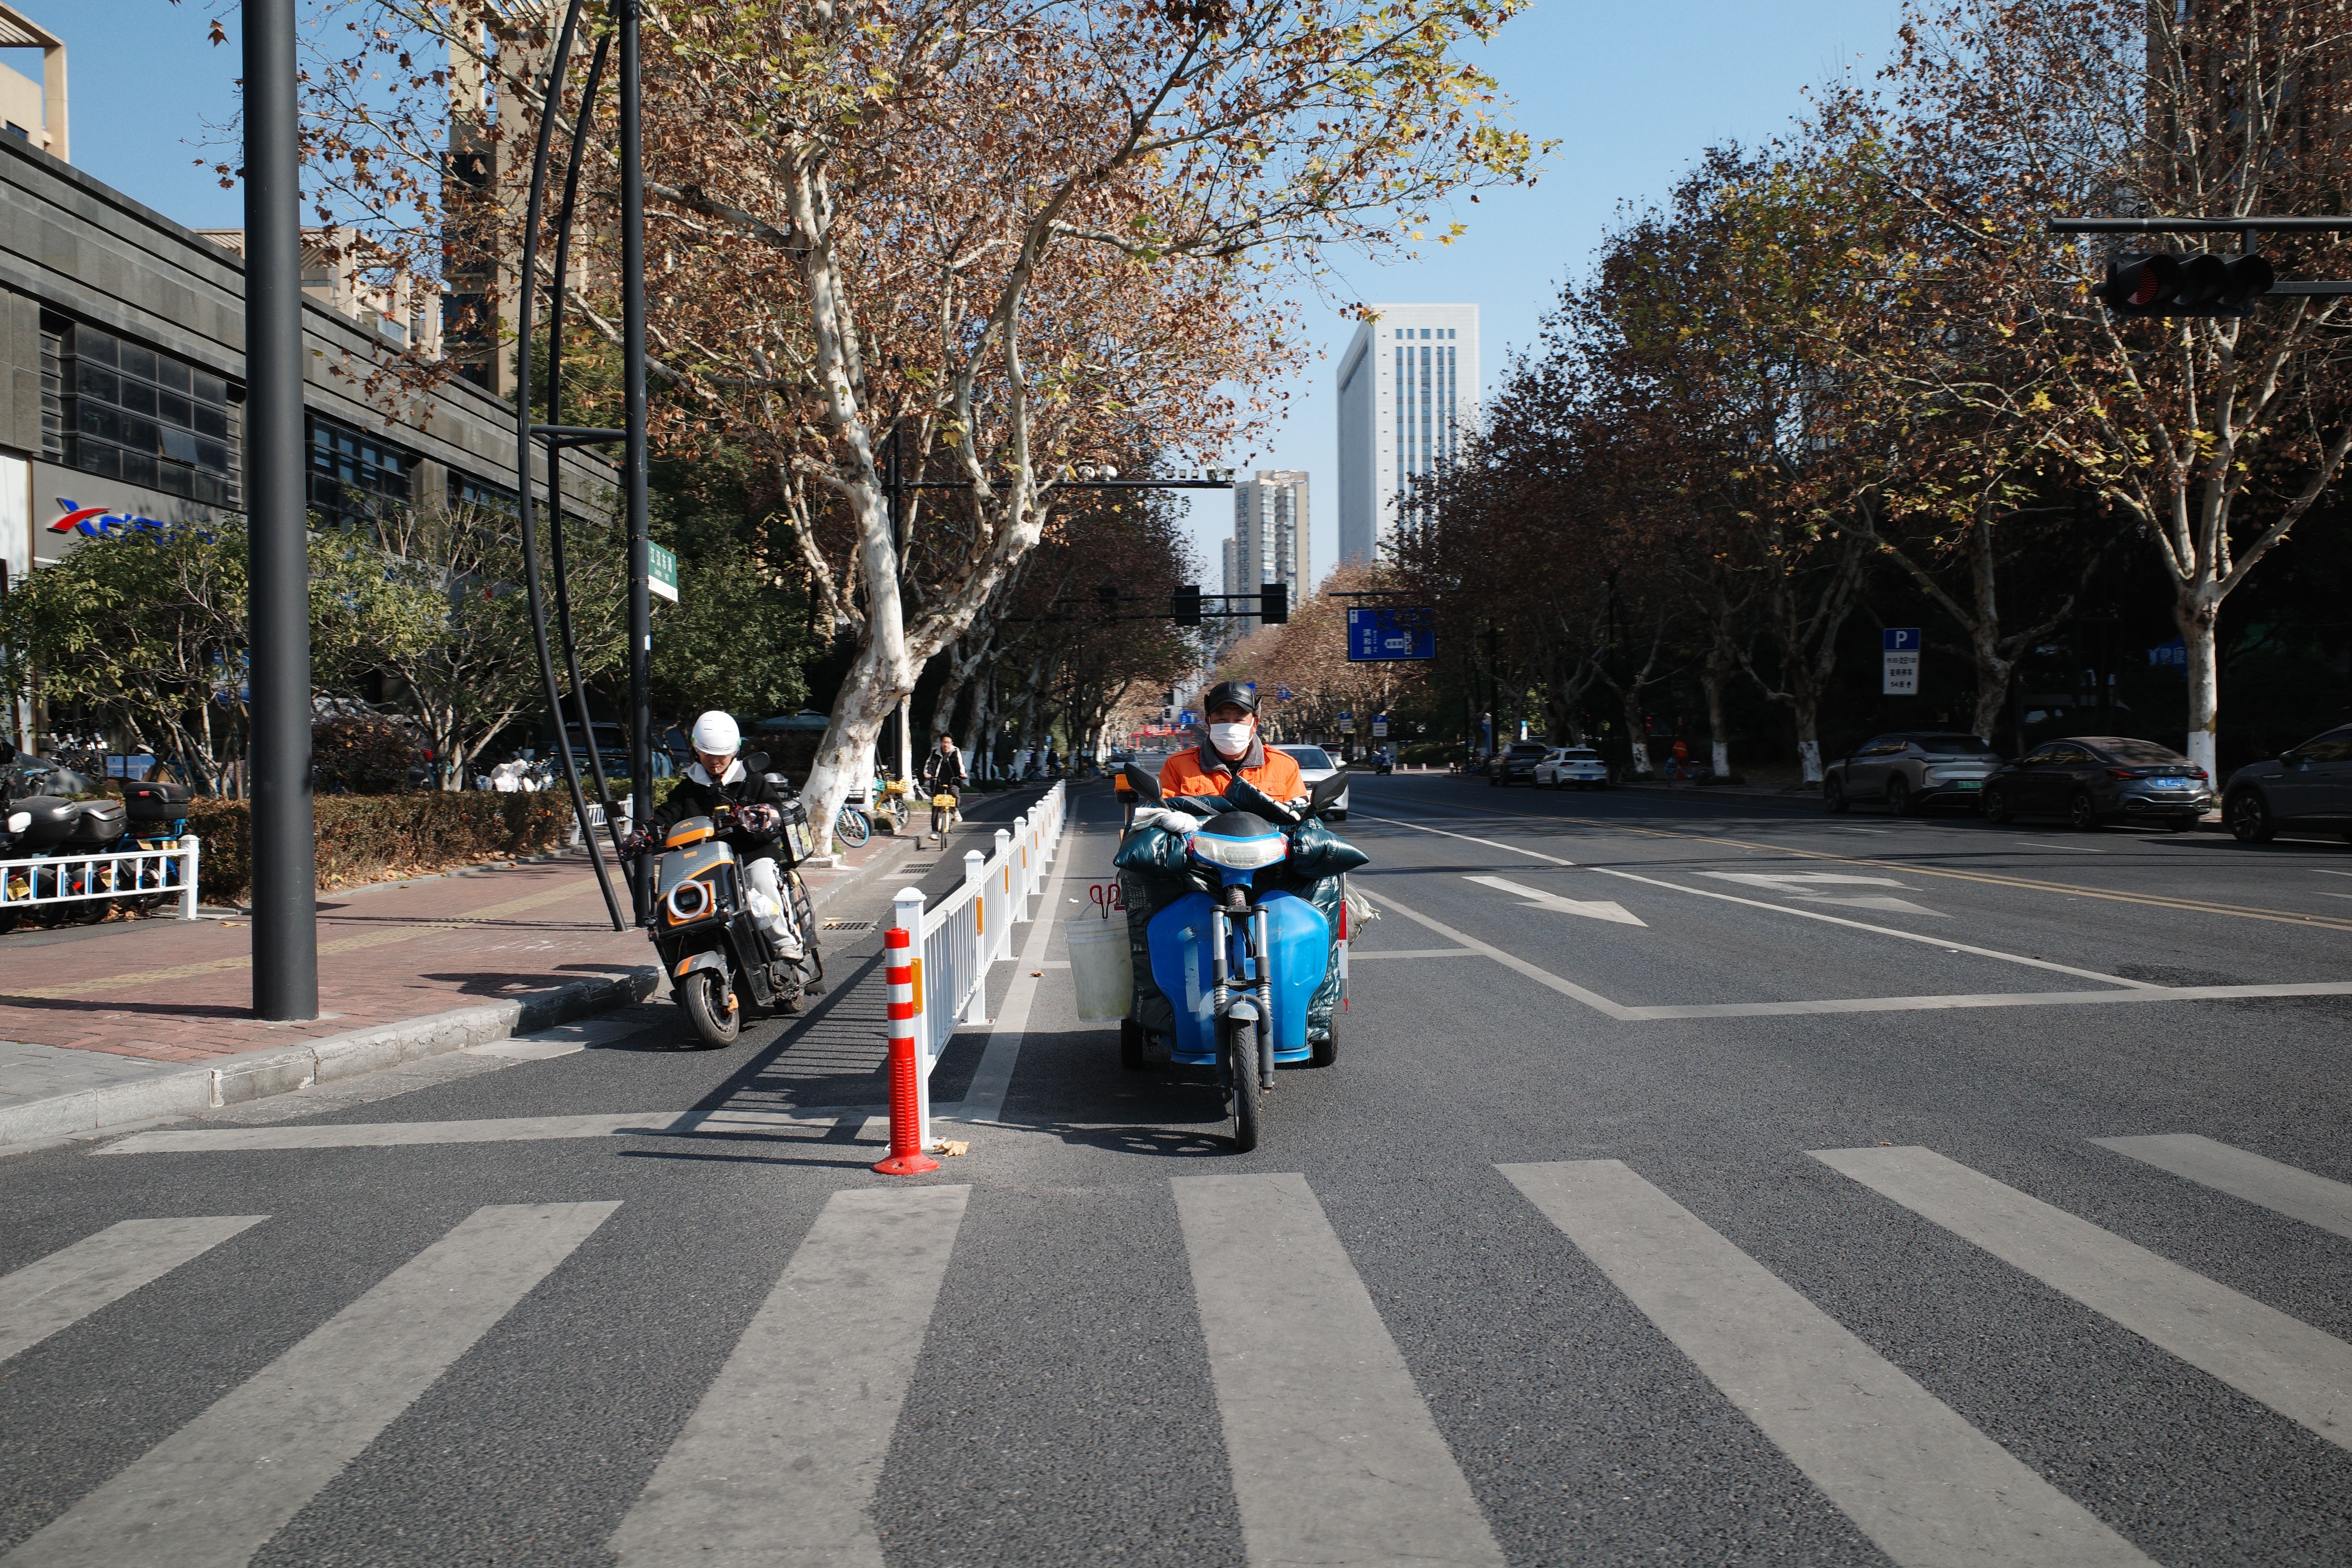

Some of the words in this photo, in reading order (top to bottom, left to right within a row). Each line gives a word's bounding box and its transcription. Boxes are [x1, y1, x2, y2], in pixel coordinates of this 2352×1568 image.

[1363, 629, 1372, 654] 滨和路
[1896, 631, 1908, 648] P
